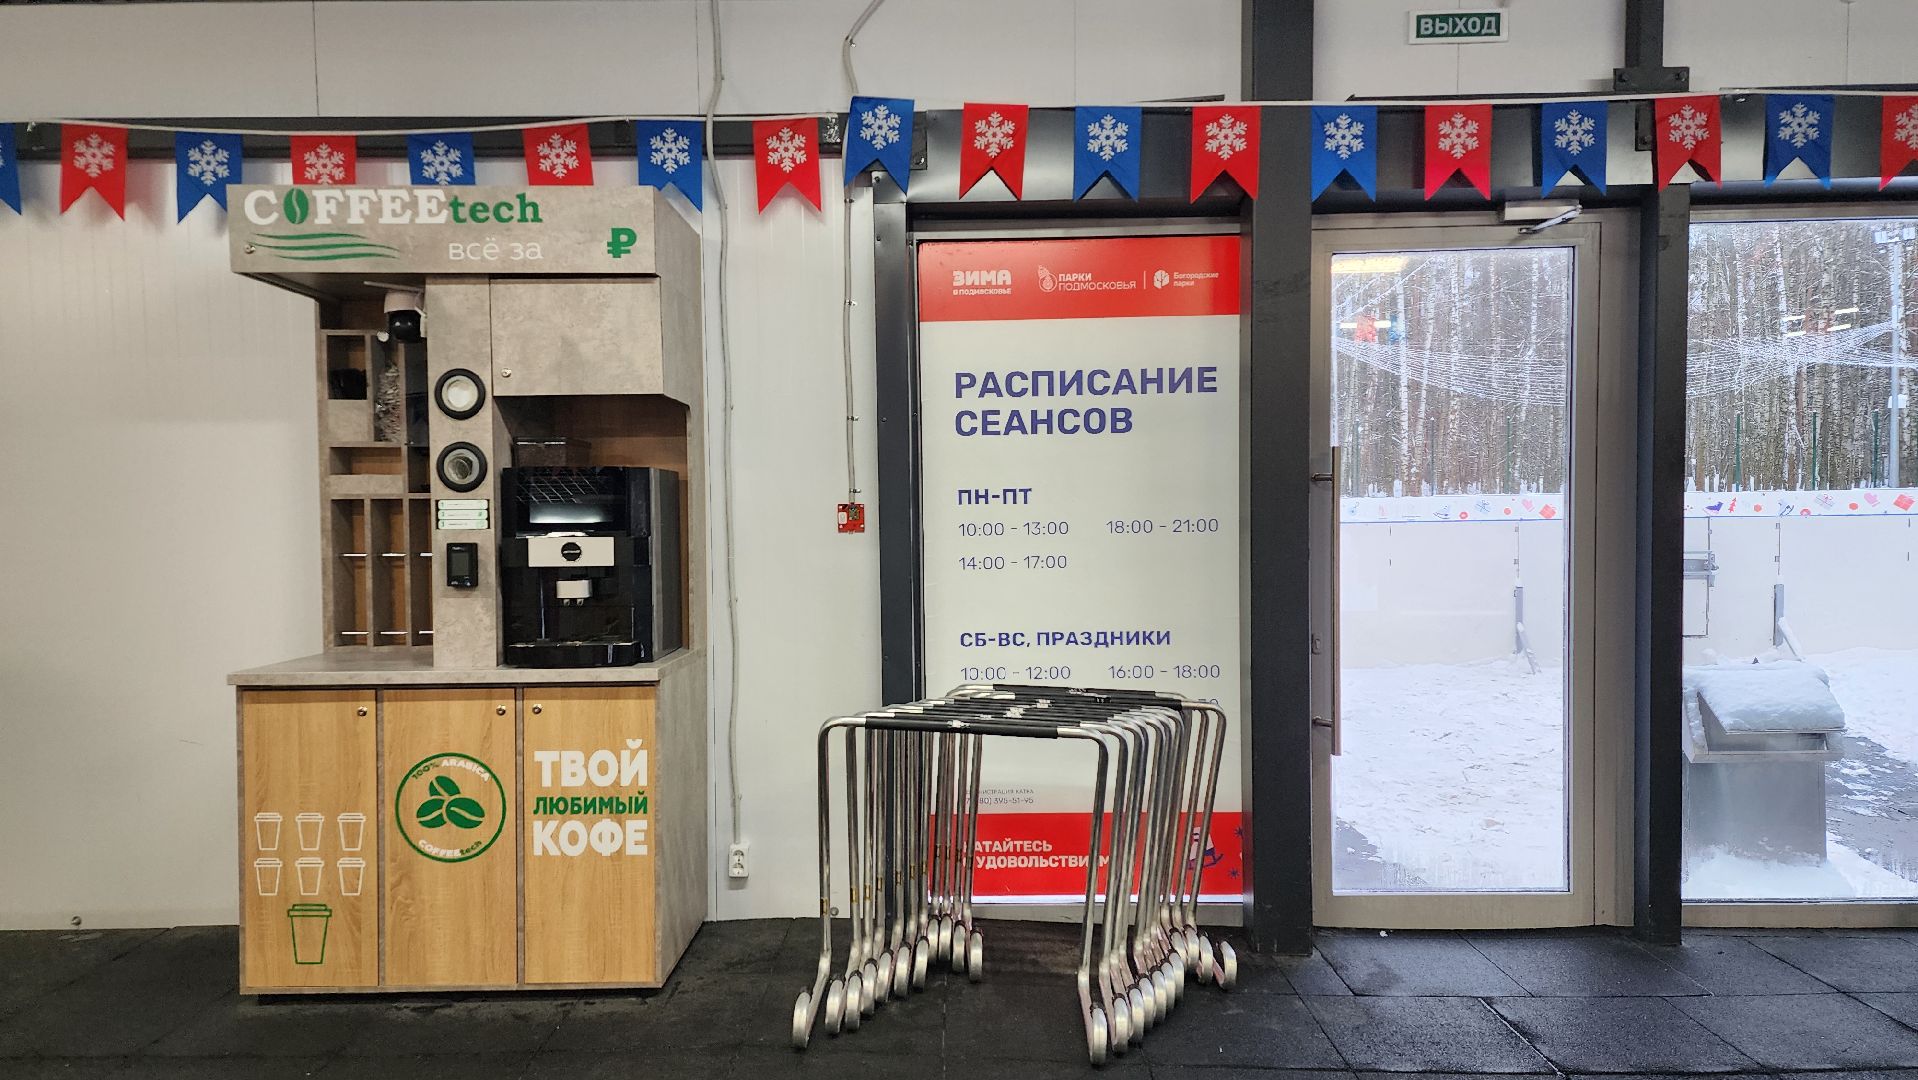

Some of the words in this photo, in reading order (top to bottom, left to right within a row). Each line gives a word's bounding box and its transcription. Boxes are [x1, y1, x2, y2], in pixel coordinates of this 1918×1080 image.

[1420, 16, 1497, 35] ВЫХОД
[449, 238, 499, 260] всё
[511, 242, 543, 260] за
[953, 269, 1012, 286] ЗИМА
[1058, 273, 1092, 282] ПАРКИ
[1173, 280, 1195, 288] парки
[959, 288, 1012, 296] ПОДМОСКОВЬЕ
[1058, 281, 1137, 292] ПОДМОСКОВЬЯ
[955, 366, 1218, 399] РАСПИСАНИЕ
[955, 407, 1133, 437] СЕАНСОВ
[958, 488, 1032, 506] ПН-ПТ
[958, 523, 1005, 537] 10:00
[1023, 521, 1070, 536] 13:00
[1106, 519, 1154, 534] 18:00
[1172, 518, 1219, 533] 21:00
[958, 556, 1005, 570] 14:00
[1023, 555, 1068, 569] 17:00
[960, 632, 1031, 648] СБ-ВС,
[1037, 630, 1172, 648] ПРАЗДНИКИ
[960, 667, 1007, 681] 10:00
[1025, 666, 1071, 680] 12:00
[1108, 665, 1154, 680] 16:00
[1174, 664, 1221, 679] 18:00
[441, 759, 490, 782] ARABICA
[533, 738, 648, 788] ТВОЙ
[533, 790, 648, 815] ЛЮБИМЫЙ
[533, 818, 648, 857] КОФЕ
[976, 855, 1109, 869] УДОВОЛЬСТВИМ
